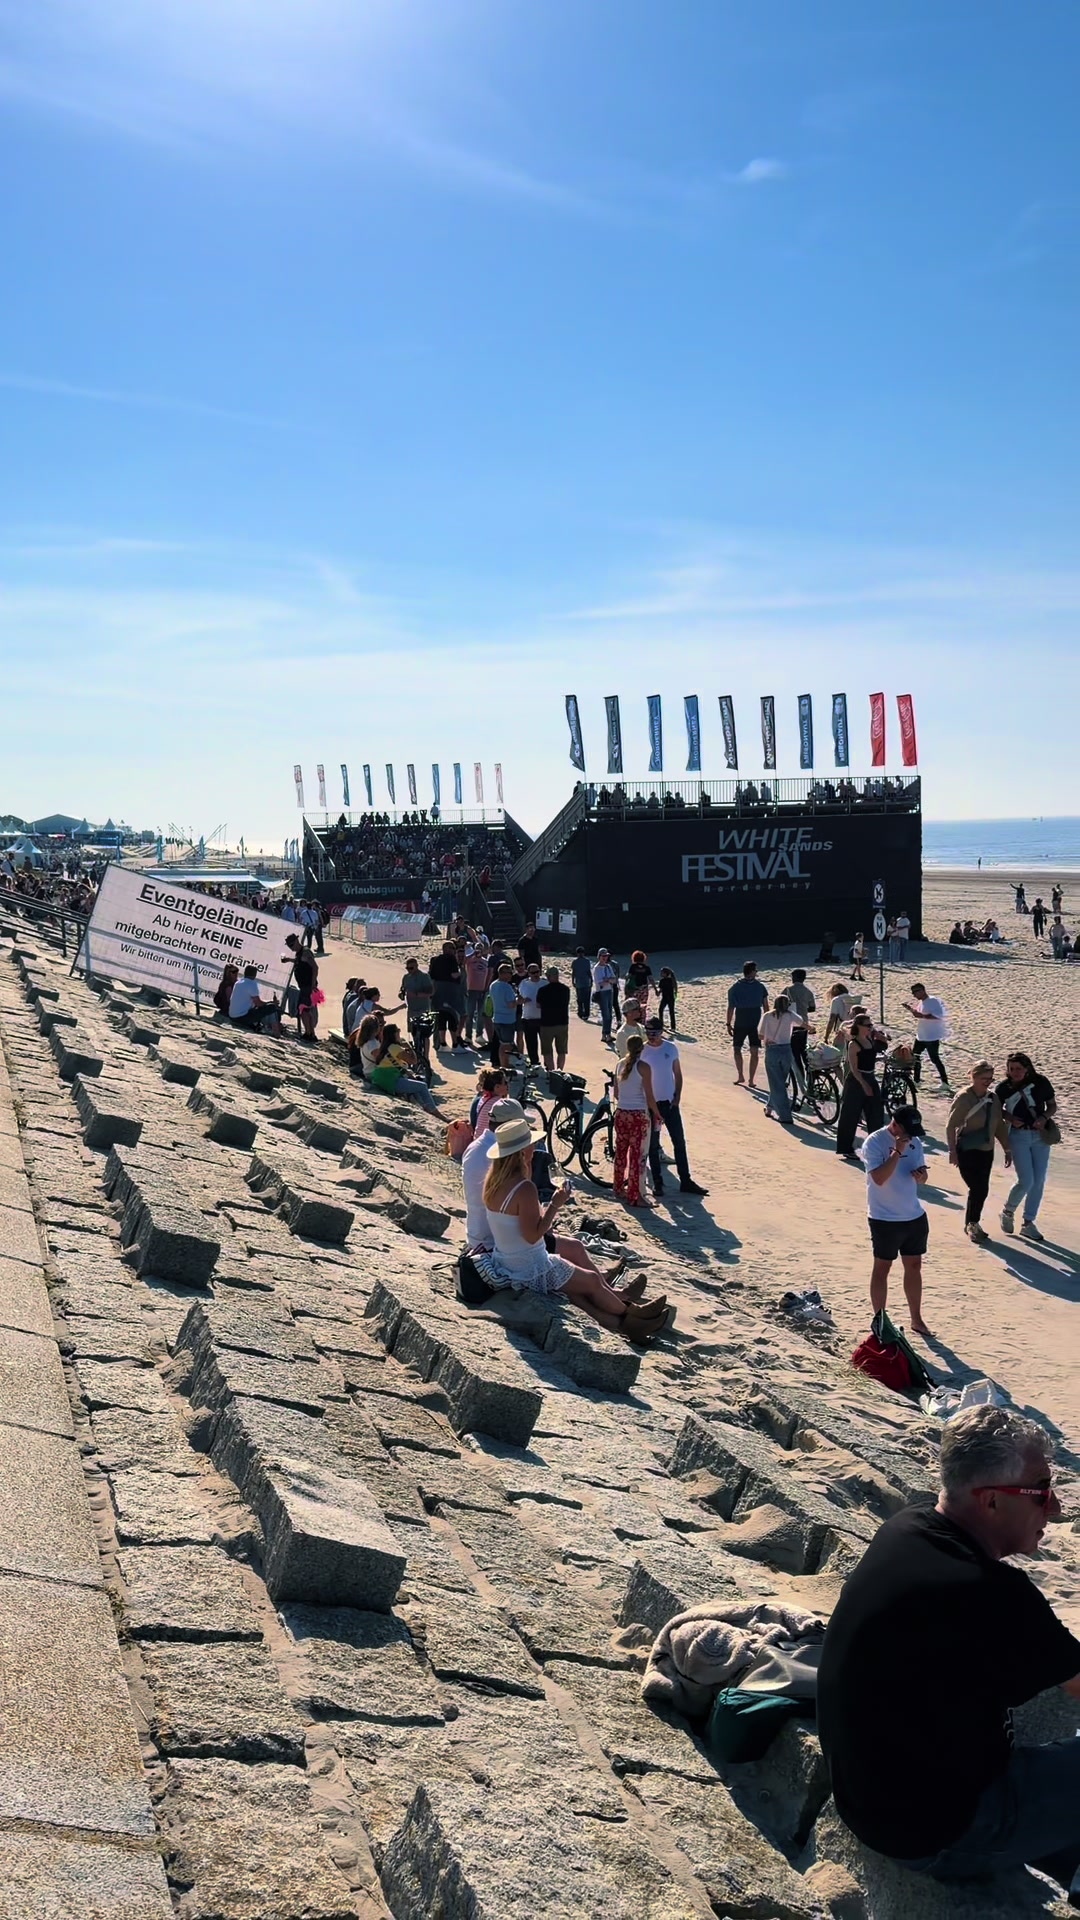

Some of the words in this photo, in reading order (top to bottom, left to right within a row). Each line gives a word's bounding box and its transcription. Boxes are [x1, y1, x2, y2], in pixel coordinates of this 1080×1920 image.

[719, 827, 813, 849] WHITE
[778, 841, 833, 852] SANDS
[681, 851, 811, 883] FESTIVAL
[342, 884, 404, 895] Urlaubsguru
[704, 881, 811, 893] Norderney
[139, 883, 268, 936] Eventgelände
[115, 921, 206, 956] mitgebrachten
[152, 914, 171, 928] Ab
[174, 920, 199, 936] hier
[200, 928, 244, 949] KEINE
[120, 943, 136, 955] Wir
[138, 949, 164, 964] bitten
[166, 958, 182, 968] um
[183, 962, 195, 972] Ihr
